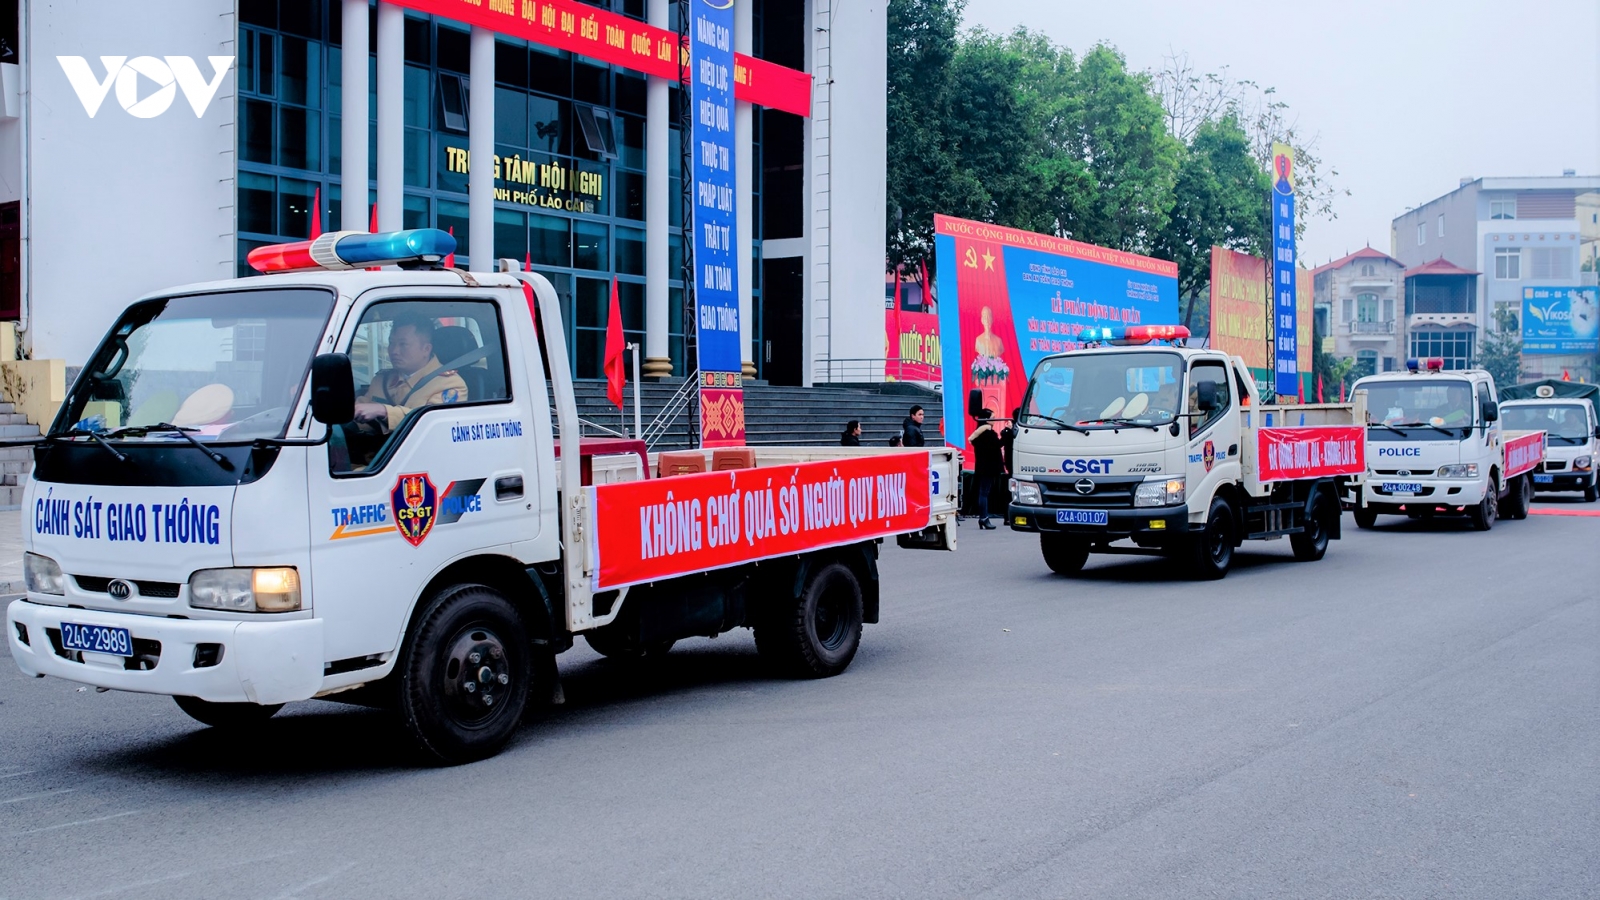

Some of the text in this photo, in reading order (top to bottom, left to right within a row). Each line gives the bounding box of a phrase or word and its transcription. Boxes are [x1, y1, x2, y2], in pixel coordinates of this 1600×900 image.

[521, 0, 536, 25] ĐẠI
[541, 4, 556, 32] HỘI
[561, 11, 575, 37] ĐẠI
[580, 13, 599, 41] BIỂU
[606, 24, 625, 49] TOÀN
[631, 31, 651, 57] QUỐC
[657, 36, 671, 62] LẦN
[733, 57, 747, 85] ẢNG
[697, 14, 730, 53] NÂNG CAO
[700, 56, 729, 96] HIỆU LỰC
[700, 96, 730, 133] HIỆU QUẢ
[701, 140, 729, 173] THỰC THI
[447, 146, 603, 200] TRG TÂM HỘI NGHỊ
[513, 188, 538, 206] PHỐ
[540, 193, 563, 210] LÀO
[698, 178, 733, 217] PHÁP LUẬT
[704, 220, 730, 257] TRẬT TỰ
[945, 221, 974, 235] NƯỚC
[976, 227, 1003, 240] CỘNG
[1005, 232, 1025, 244] HOÀ
[1027, 236, 1039, 247] XÃ
[1040, 239, 1056, 252] HỘI
[1058, 242, 1075, 254] CHỦ
[1076, 246, 1101, 259] NGHĨA
[1101, 251, 1119, 263] VIỆT
[1119, 255, 1135, 266] NAM
[1136, 259, 1157, 270] MUÔN
[1157, 262, 1171, 274] NĂM
[704, 262, 732, 292] AN TOÀN
[700, 302, 738, 332] GIAO THÔNG
[1051, 290, 1141, 325] LỄ PHÁT ĐỘNG RA QUÂN
[1028, 316, 1039, 332] NĂM
[1039, 320, 1047, 333] AN
[1047, 318, 1059, 335] TOÀN
[1060, 321, 1071, 335] GIAO
[900, 324, 941, 373] NƯỚC CỘN
[1030, 338, 1038, 350] AN
[1038, 336, 1050, 351] TOÀN
[451, 418, 523, 443] CẢNH SÁT GIAO THÔNG
[1061, 458, 1114, 475] CSGT
[1188, 451, 1226, 463] TRAFFIC POLICE
[1379, 447, 1421, 457] POLICE
[1020, 465, 1047, 473] HINO
[35, 486, 220, 545] CẢNH SÁT GIAO THÔNG
[331, 494, 482, 526] TRAFFIC POLICE
[639, 467, 908, 560] KHÔNG CHỞ QUÁ SỐ NGƯỜI QUY ĐỊNH
[1058, 511, 1105, 523] 24A-001.07
[110, 583, 127, 595] KIA
